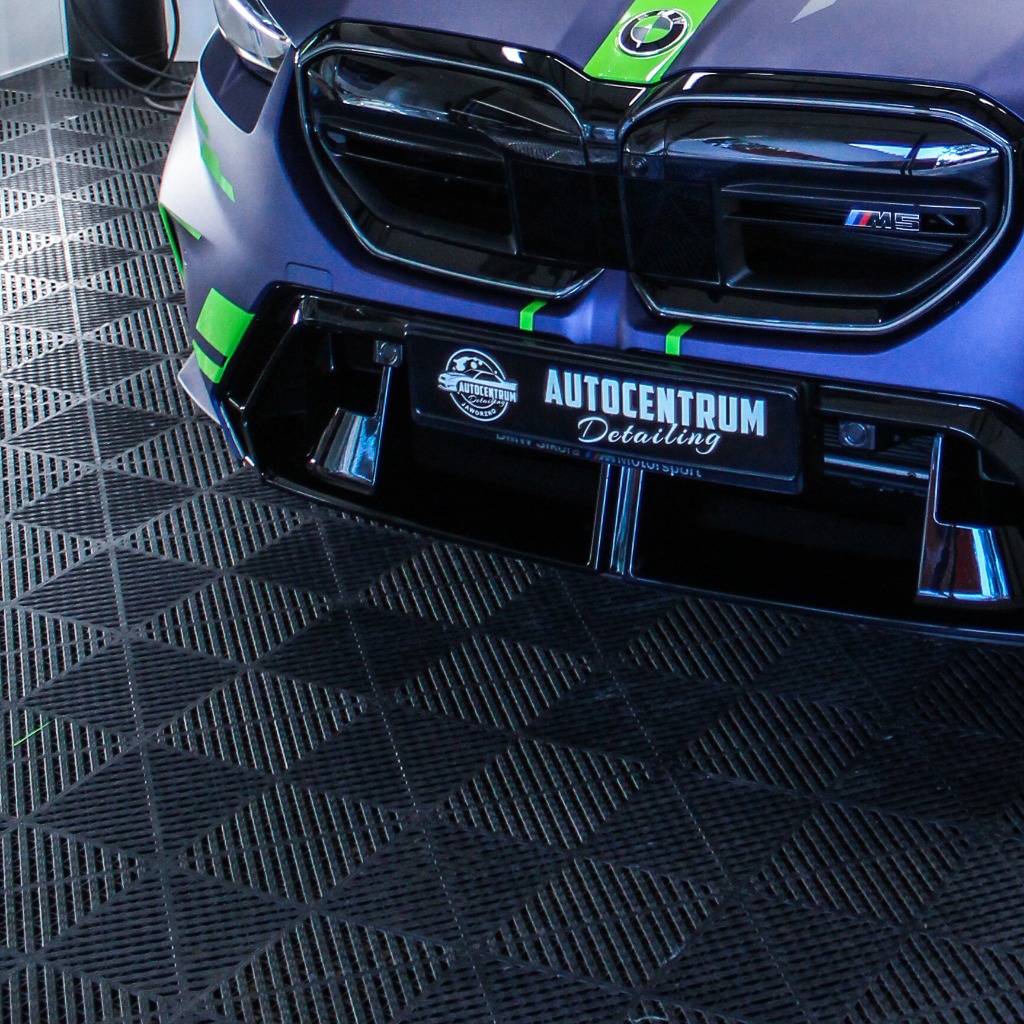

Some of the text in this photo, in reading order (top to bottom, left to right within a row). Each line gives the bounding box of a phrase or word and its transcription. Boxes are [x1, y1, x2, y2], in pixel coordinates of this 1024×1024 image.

[863, 210, 920, 232] M5
[458, 381, 518, 403] AUTOCENTRUM
[468, 394, 506, 407] Detailing
[544, 368, 765, 437] AUTOCENTRUM
[461, 402, 497, 417] JAWORZNO
[577, 416, 721, 455] Detailing
